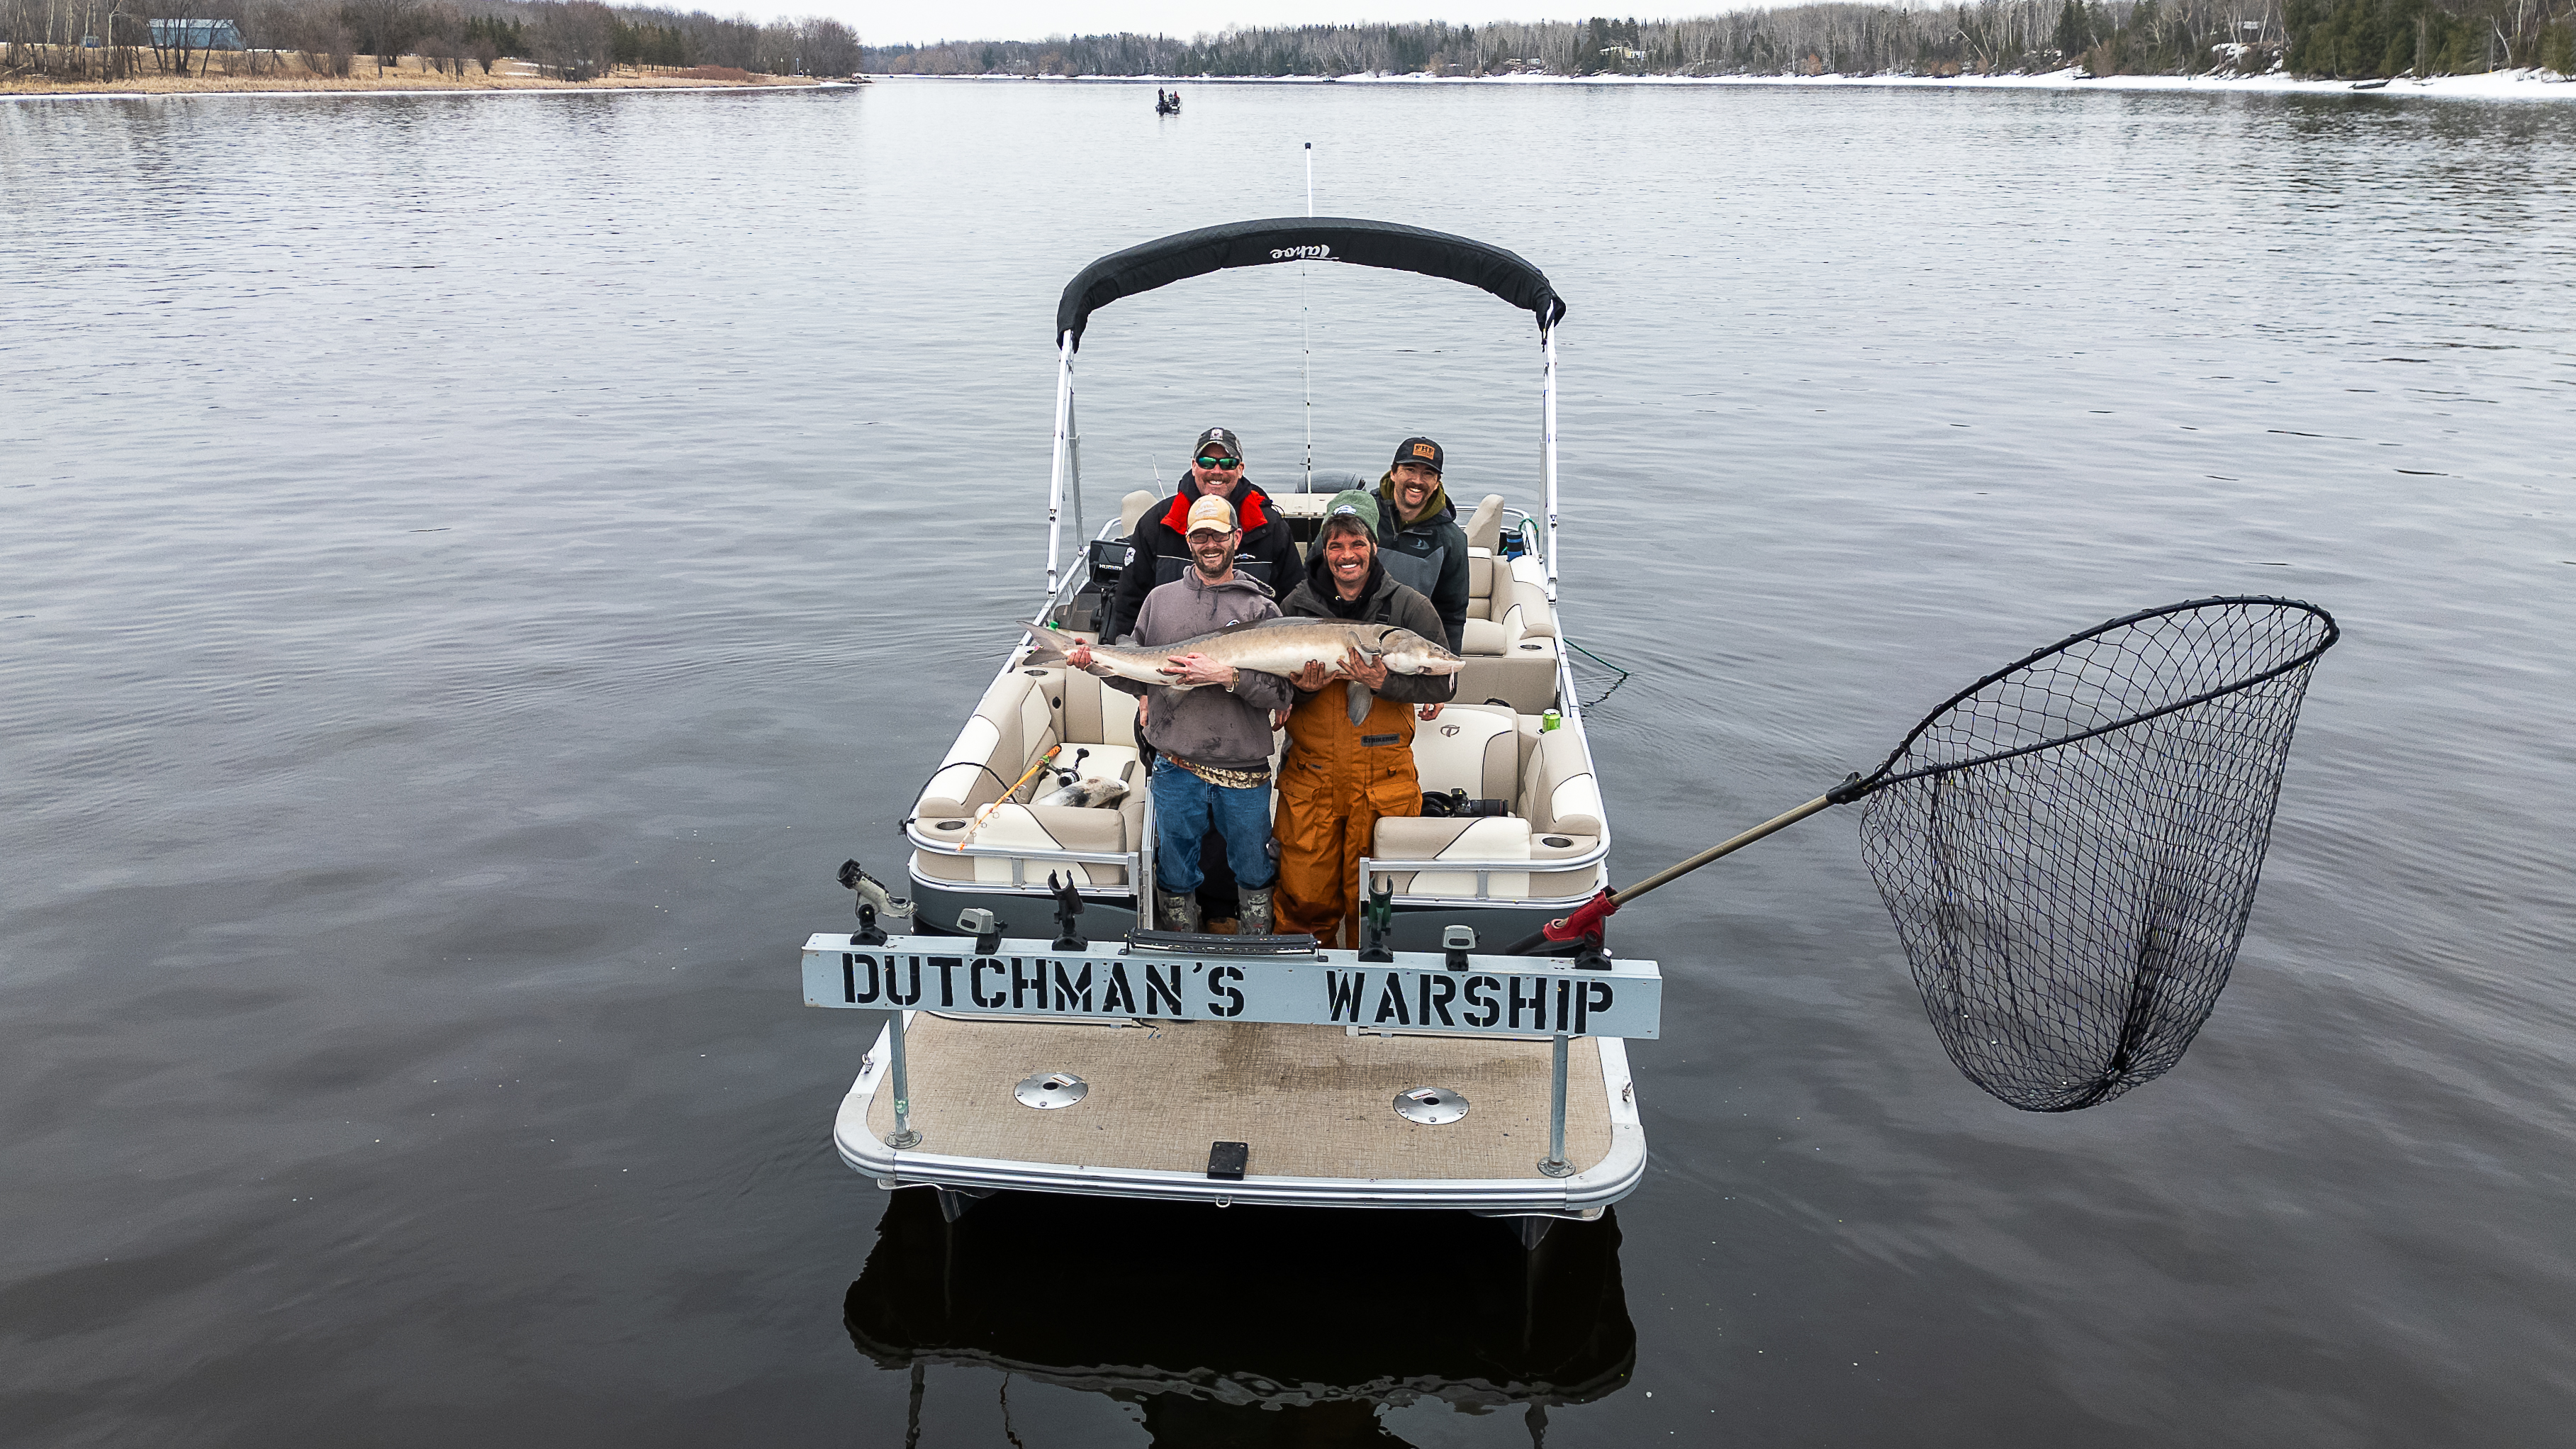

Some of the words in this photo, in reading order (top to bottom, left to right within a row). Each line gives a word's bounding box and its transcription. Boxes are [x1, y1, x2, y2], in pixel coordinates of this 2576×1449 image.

[1270, 244, 1339, 259] Tahoe
[842, 953, 1245, 1017] DUTCHMAN'S
[1326, 970, 1613, 1034] WARSHIP
